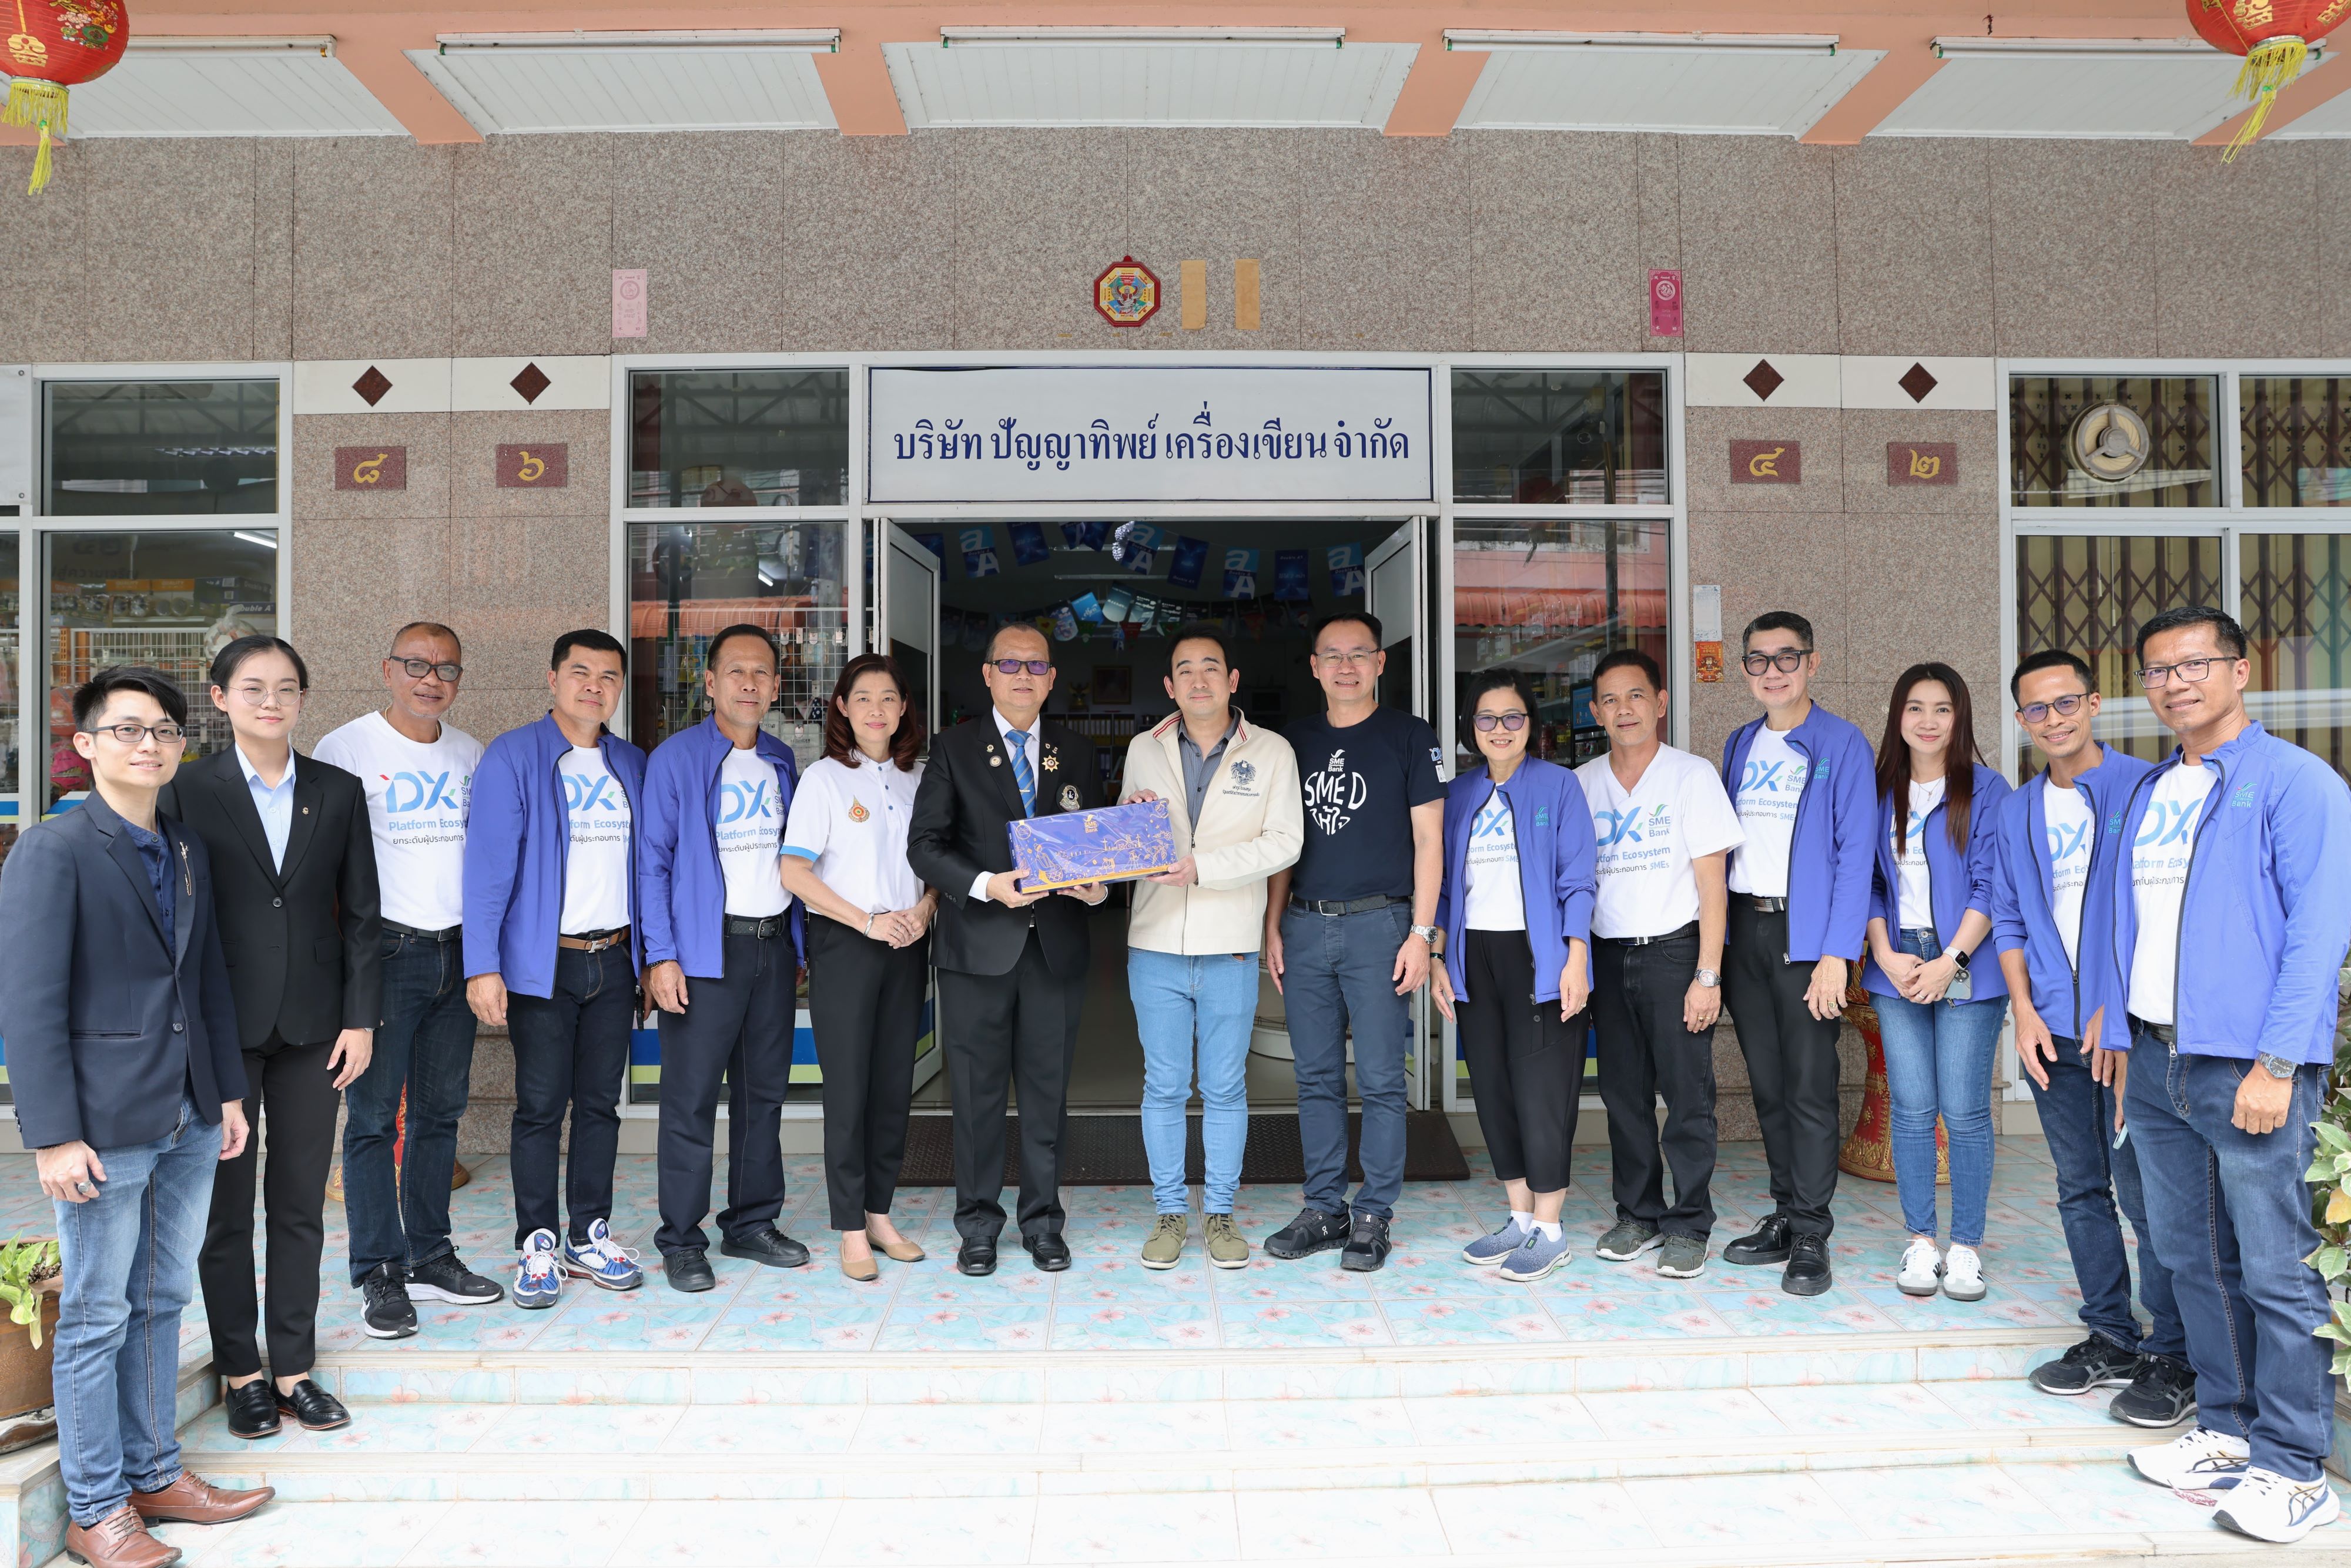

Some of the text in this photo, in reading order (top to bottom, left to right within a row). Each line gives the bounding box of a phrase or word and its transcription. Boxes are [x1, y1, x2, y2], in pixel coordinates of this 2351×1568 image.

[895, 401, 1408, 470] บริษัท ปัญญาทิพย์ เครื่องเขียน จำกัด
[354, 454, 387, 483] ๘
[518, 451, 544, 481] ๖
[1750, 448, 1784, 476] ๔
[1911, 451, 1940, 478] ๒
[976, 552, 1000, 577] A
[1128, 551, 1153, 575] A
[1230, 575, 1255, 599] A
[1343, 569, 1365, 595] A
[1304, 771, 1346, 807] SME
[2232, 800, 2252, 808] Bank
[389, 820, 436, 831] Platform
[1649, 816, 1671, 826] SME
[1649, 828, 1670, 837] Bank
[393, 835, 464, 845] ยกระดับผู้ประกอบการ
[1622, 846, 1670, 860] Ecosystem
[1650, 860, 1670, 870] SMEs
